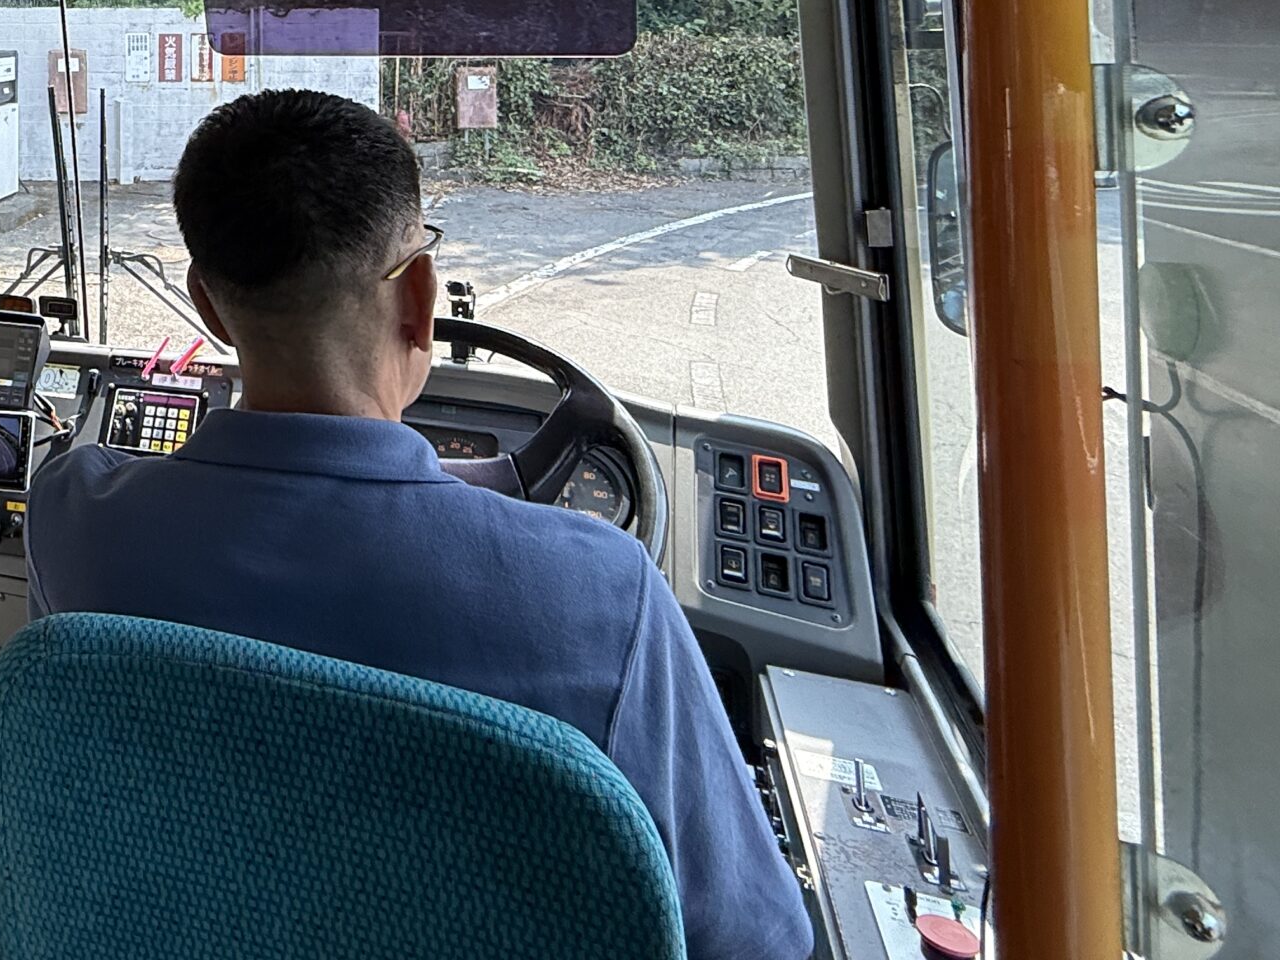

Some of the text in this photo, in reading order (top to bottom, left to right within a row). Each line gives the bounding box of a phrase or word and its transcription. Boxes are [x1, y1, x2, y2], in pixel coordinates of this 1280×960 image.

[115, 358, 150, 368] ブレーキオイ
[583, 471, 596, 480] 80
[593, 490, 608, 499] 100
